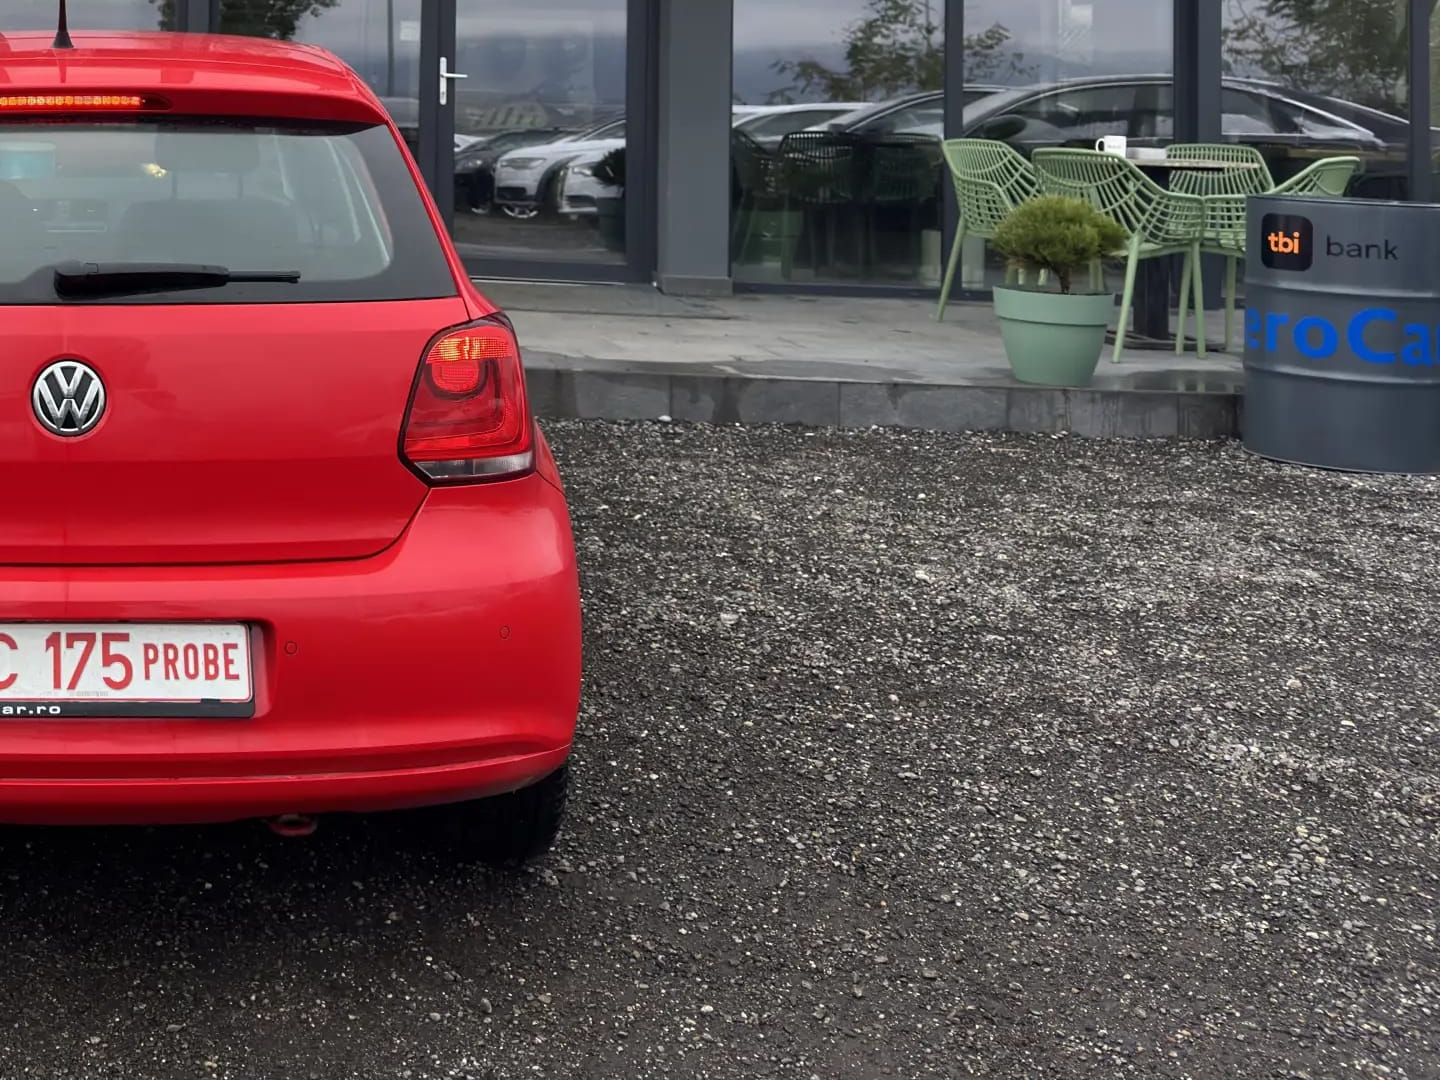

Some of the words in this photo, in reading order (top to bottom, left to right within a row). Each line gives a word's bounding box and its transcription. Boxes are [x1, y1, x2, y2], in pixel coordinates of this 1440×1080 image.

[1267, 231, 1301, 255] tbi
[1326, 235, 1400, 261] bank
[1246, 306, 1440, 367] eroCa
[44, 631, 134, 691] 175
[143, 642, 240, 681] PROBE
